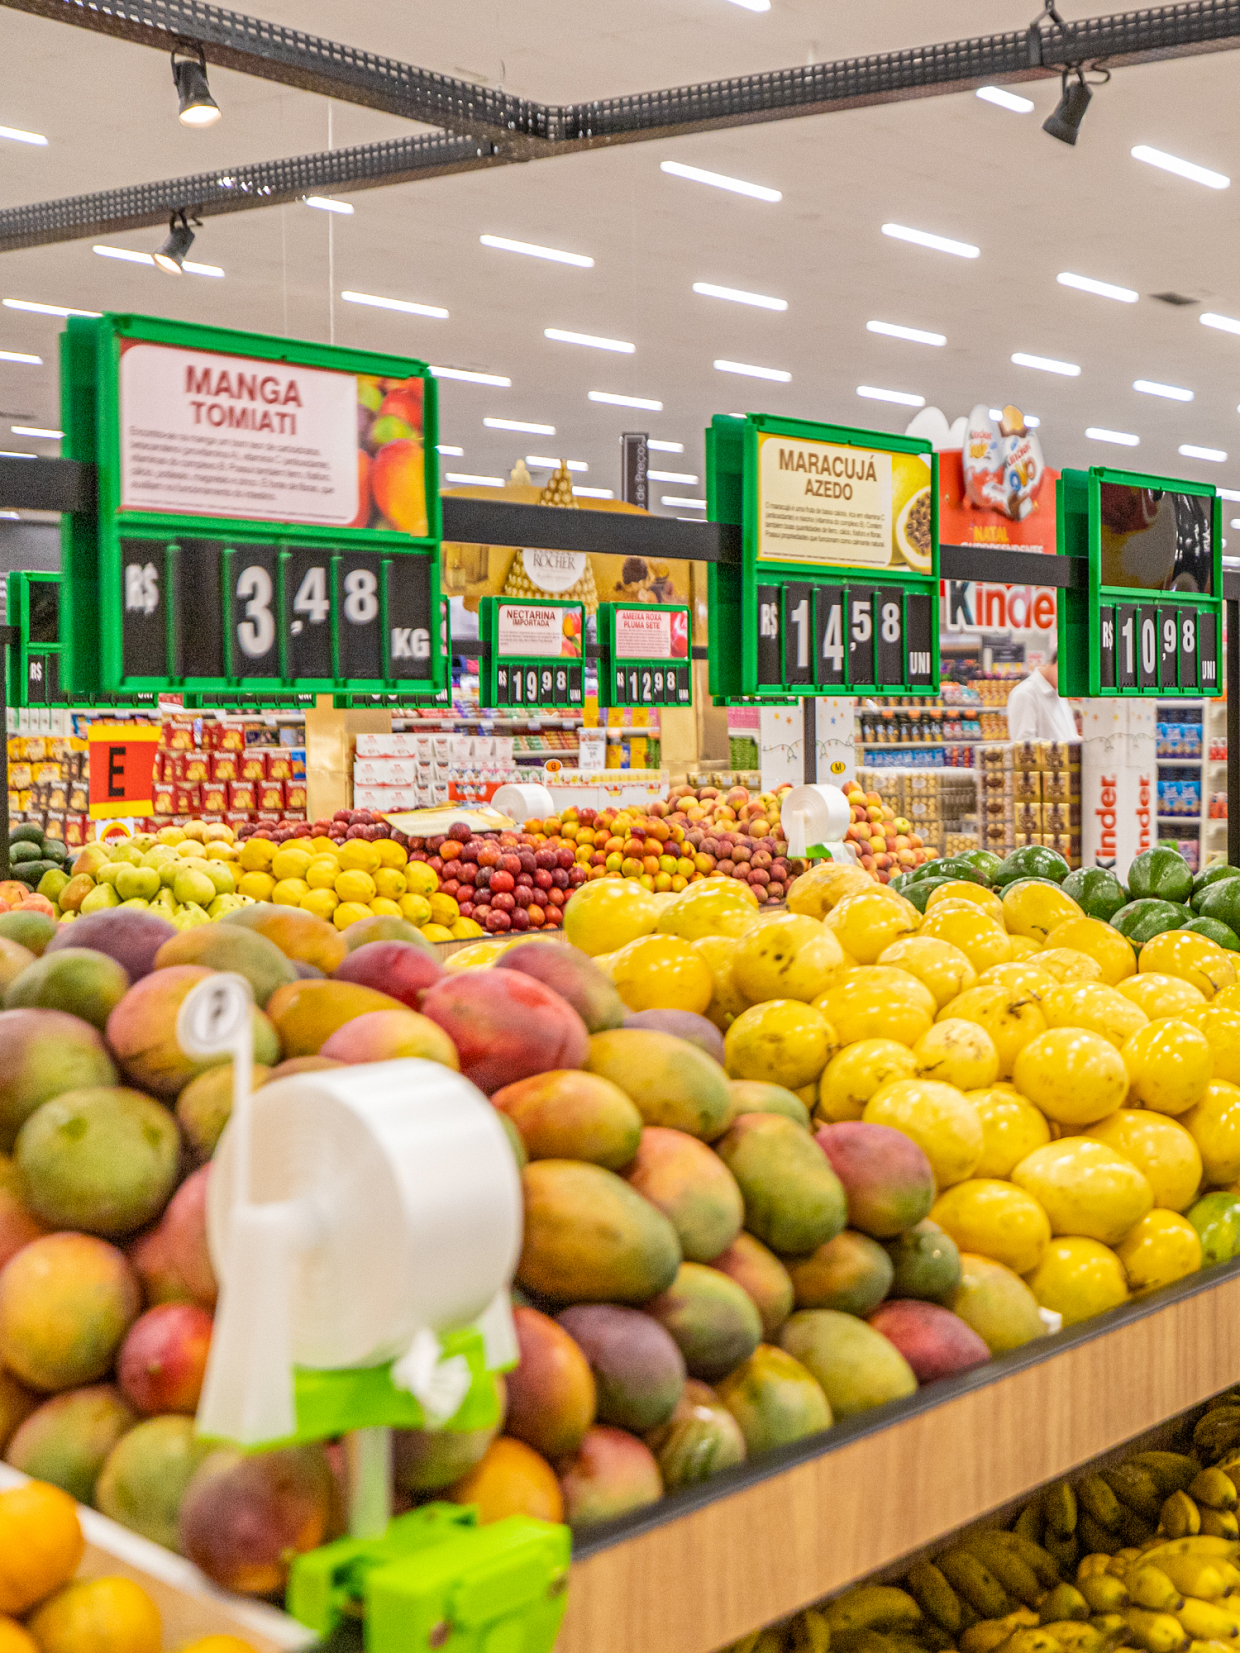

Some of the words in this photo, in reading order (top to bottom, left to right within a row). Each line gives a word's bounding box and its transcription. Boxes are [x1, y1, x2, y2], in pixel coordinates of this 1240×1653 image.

[185, 364, 303, 408] MANGA
[190, 400, 298, 436] TOMIATI
[778, 448, 878, 482] MARACUJÁ
[804, 478, 853, 501] AZEDO
[974, 526, 1009, 542] NATAL
[533, 552, 576, 570] ROCHER
[124, 562, 160, 615] R$
[236, 565, 378, 658] 3,48
[506, 609, 556, 620] NECTARINA
[622, 612, 642, 621] AMEIXA
[642, 612, 662, 622] ROXA
[950, 580, 1055, 630] Kinde
[512, 618, 550, 628] IMPORTADA
[624, 620, 644, 629] PLUMA
[646, 622, 660, 630] SETE
[760, 602, 778, 640] R$
[791, 600, 900, 672] 14,58
[390, 627, 430, 660] KG
[1102, 620, 1114, 651] R$
[1122, 618, 1195, 674] 10,98
[30, 662, 42, 682] R$
[909, 652, 930, 674] UNI
[1202, 660, 1216, 680] UNI
[498, 670, 507, 688] R$
[513, 671, 566, 701] 19,98
[570, 689, 581, 701] UNI
[630, 671, 676, 701] 12,98
[108, 746, 126, 798] E
